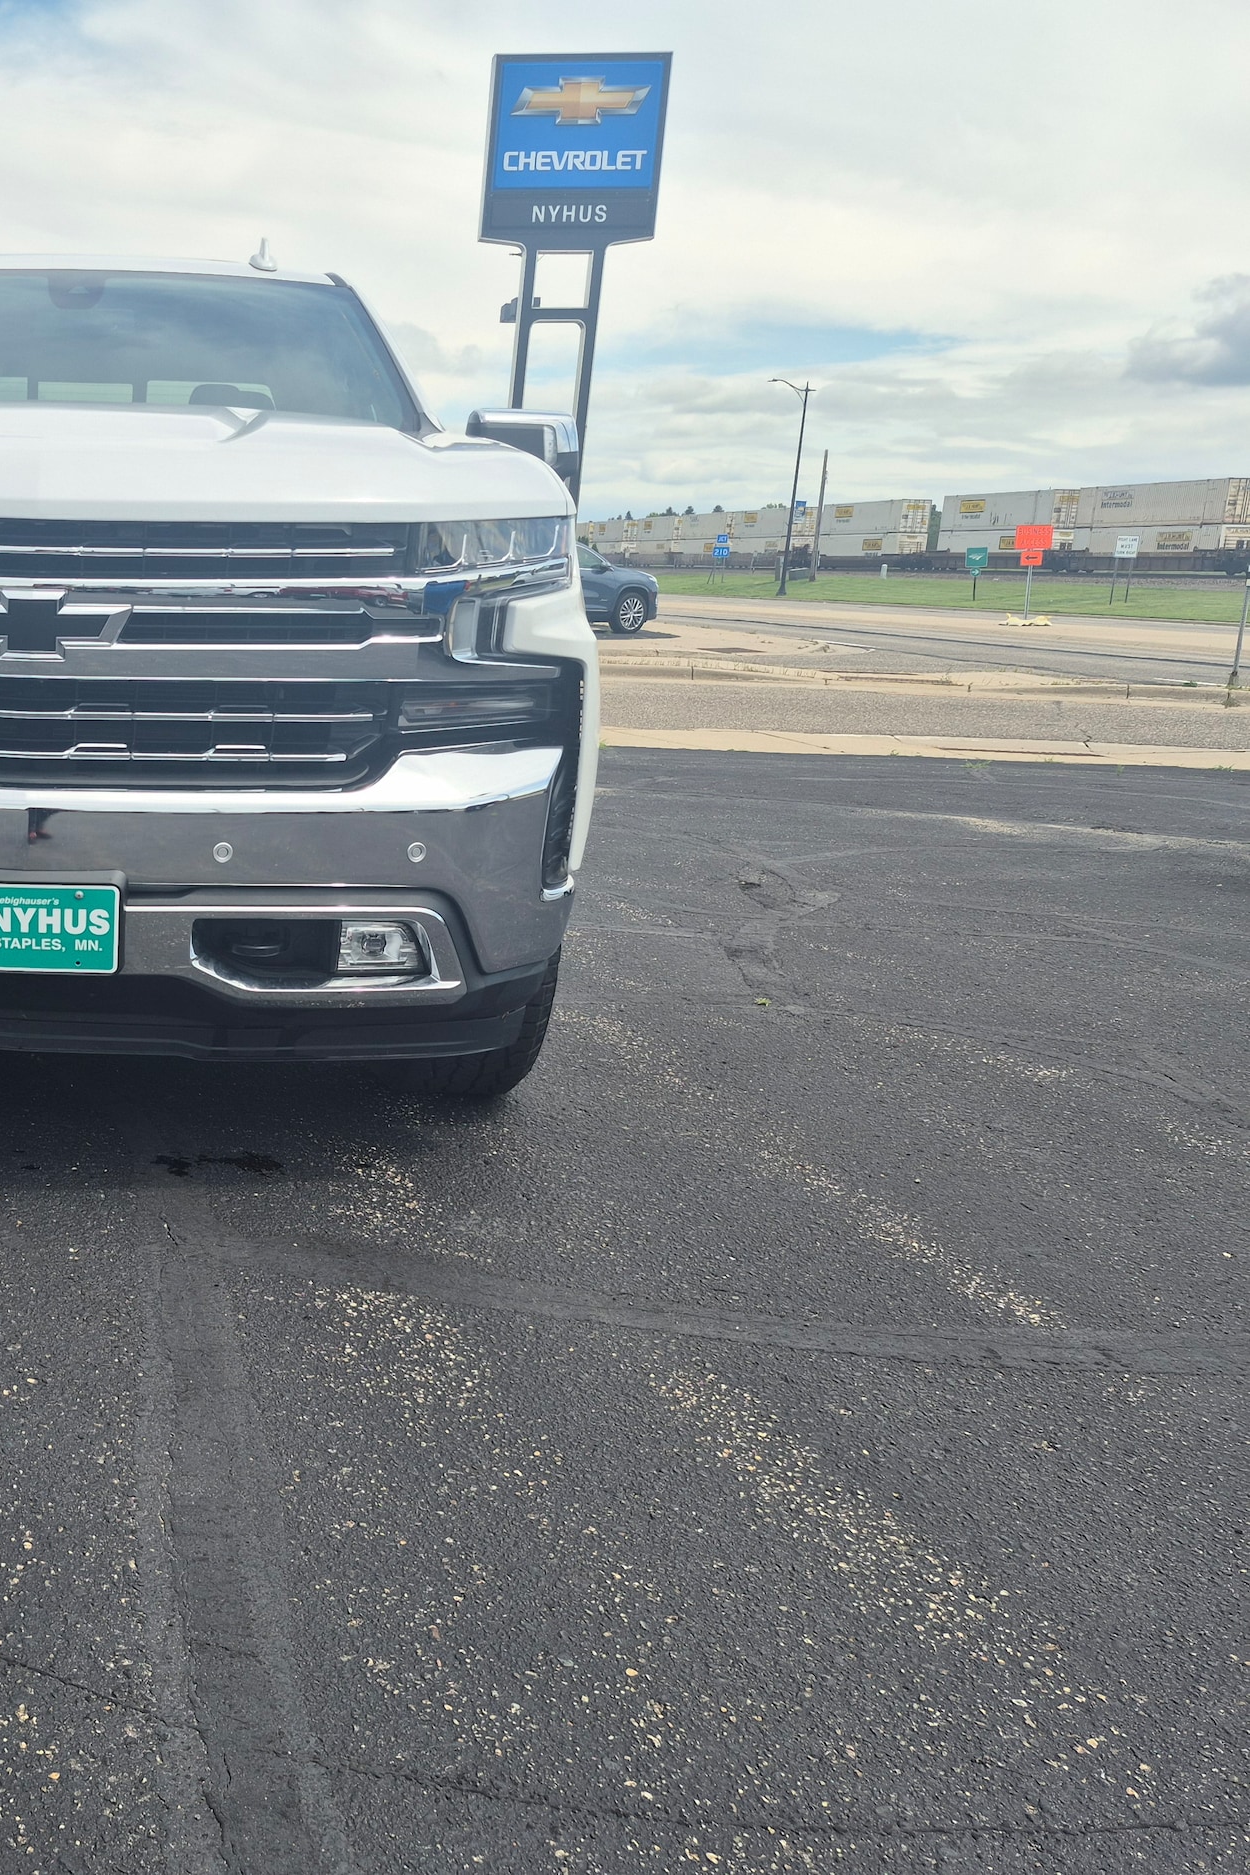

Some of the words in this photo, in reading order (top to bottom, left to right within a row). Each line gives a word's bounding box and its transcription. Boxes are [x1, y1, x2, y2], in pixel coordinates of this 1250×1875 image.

[503, 150, 648, 171] CHEVROLET
[531, 204, 608, 223] NYHUS
[1018, 527, 1051, 535] BUSINESS
[1020, 538, 1047, 546] ACCESS
[1157, 542, 1189, 550] Intermodal
[714, 548, 728, 556] 210
[75, 939, 103, 951] MN.
